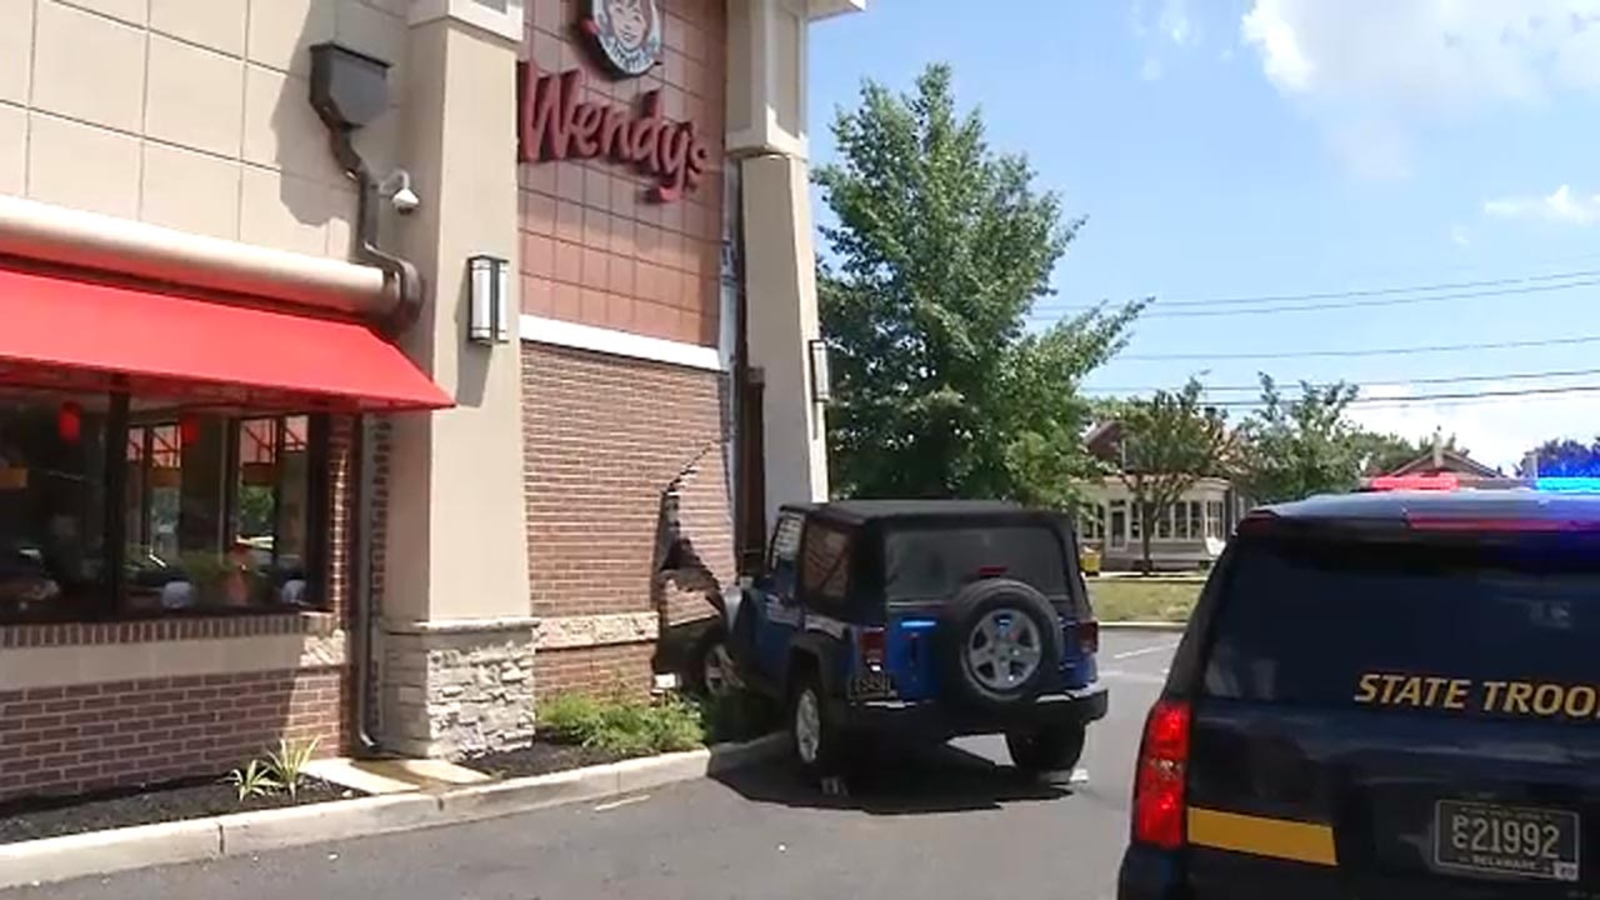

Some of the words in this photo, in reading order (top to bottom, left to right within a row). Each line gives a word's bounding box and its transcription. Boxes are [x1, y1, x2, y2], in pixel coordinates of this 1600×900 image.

[519, 60, 708, 201] Wendy's
[1354, 674, 1471, 708] STATE
[1482, 681, 1600, 717] TROO
